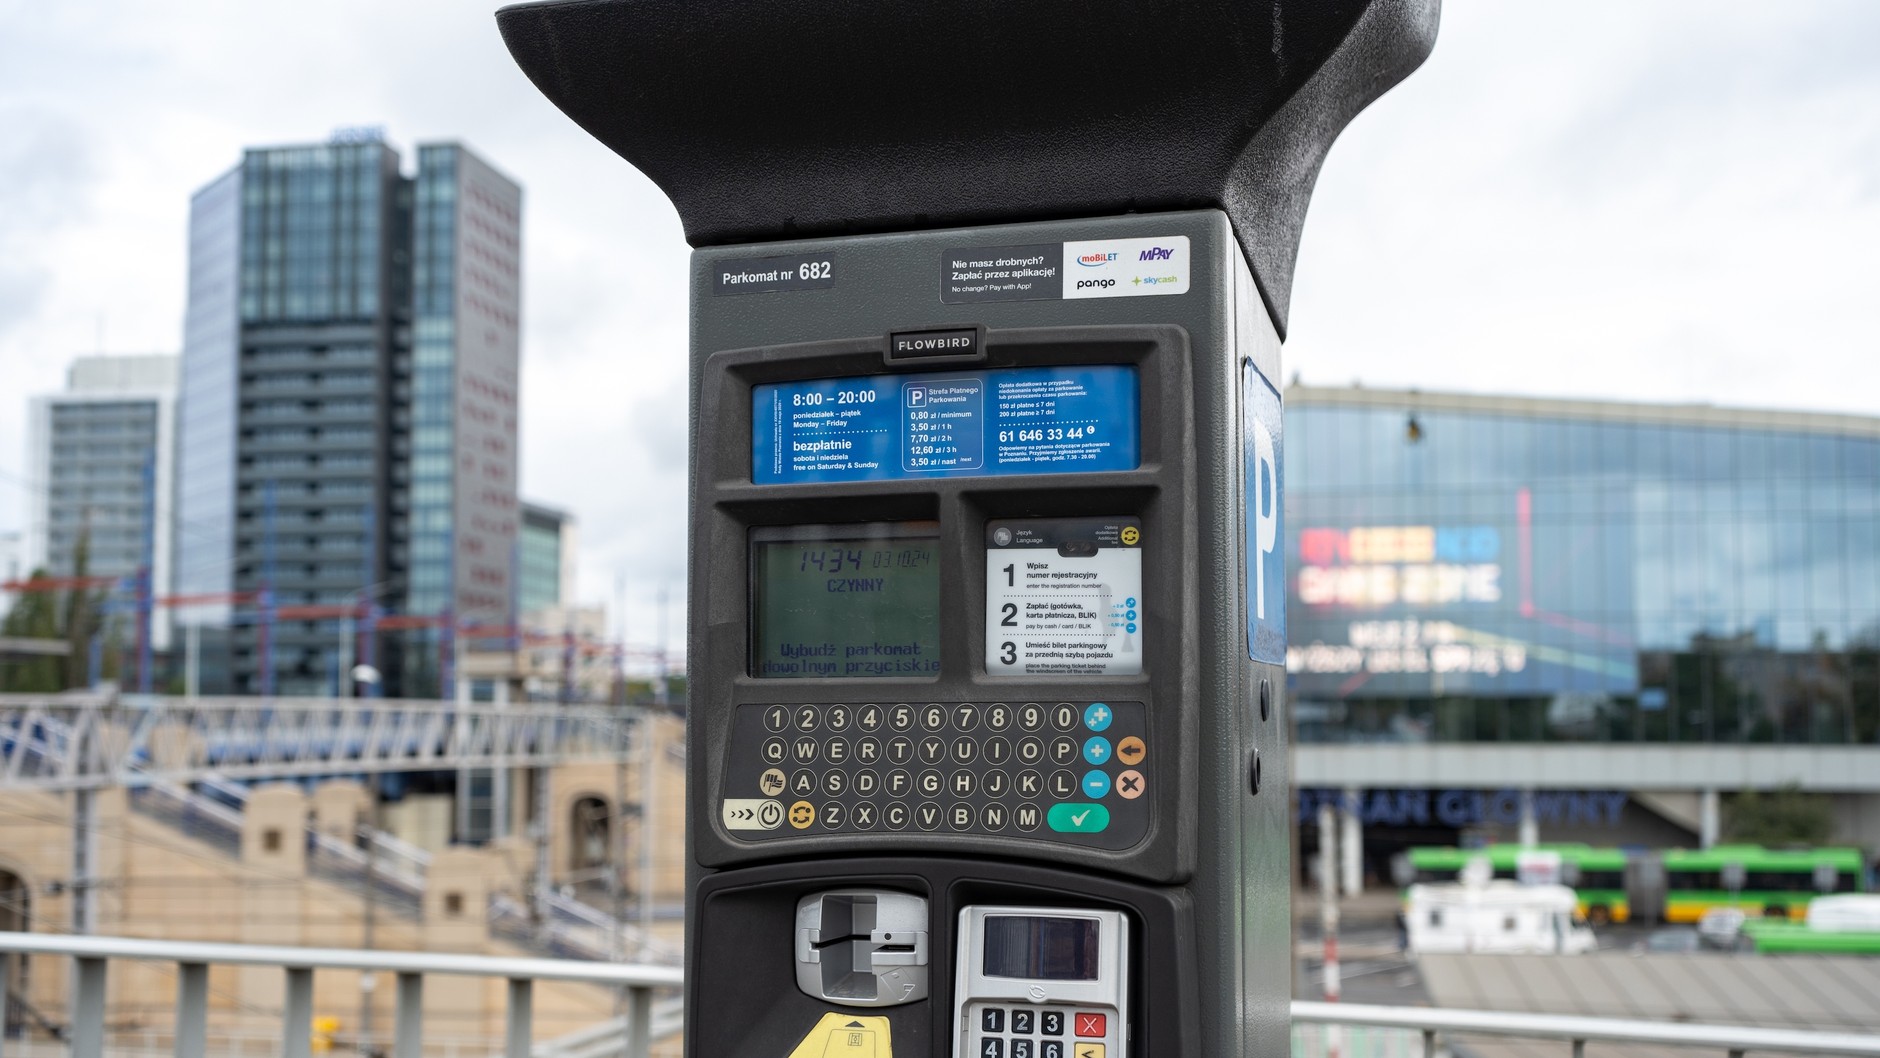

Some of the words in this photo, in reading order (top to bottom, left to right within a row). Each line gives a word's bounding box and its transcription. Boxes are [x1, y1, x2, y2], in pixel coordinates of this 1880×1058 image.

[1139, 247, 1174, 261] MPAY
[952, 260, 967, 268] Nie
[996, 256, 1044, 267] drobnych?
[723, 270, 778, 284] Parkomat
[781, 270, 793, 280] nr
[799, 262, 830, 280] 682
[952, 271, 982, 281] Zapłać
[984, 272, 1010, 280] przez
[1012, 268, 1056, 278] aplikację!
[1077, 278, 1116, 290] pango
[1144, 276, 1177, 285] skycash
[898, 338, 970, 350] FLOWBIRD
[793, 392, 822, 406] 8:00
[838, 390, 876, 404] 20:00
[912, 390, 922, 404] P
[793, 411, 834, 420] poniedziałek
[841, 410, 861, 418] piątek
[910, 412, 928, 420] 0,80
[910, 423, 928, 432] 3,50
[910, 434, 928, 444] 7,70
[999, 430, 1014, 442] 61
[1019, 429, 1043, 442] 646
[1047, 428, 1063, 440] 33
[1067, 428, 1083, 439] 44
[793, 439, 852, 452] bezpłatnie
[910, 446, 933, 455] 12,60
[911, 458, 928, 467] 3,50
[1254, 416, 1277, 620] P
[1004, 564, 1014, 587] 1
[828, 578, 884, 593] CZYNNY
[1000, 603, 1018, 626] 2
[780, 642, 836, 658] Wybudź
[846, 642, 921, 658] parkomat
[1000, 642, 1017, 665] 3
[762, 659, 836, 673] dowolnym
[772, 710, 780, 728] 1
[801, 710, 813, 728] 2
[832, 709, 844, 728] 3
[864, 709, 876, 727] 4
[896, 709, 908, 727] 5
[928, 708, 940, 726] 6
[960, 708, 972, 726] 7
[992, 708, 1004, 726] 8
[1026, 708, 1038, 726] 9
[1058, 708, 1070, 726] 0
[768, 742, 782, 759] Q
[798, 743, 815, 758] W
[832, 743, 842, 758] E
[862, 743, 875, 758] R
[894, 743, 906, 758] T
[926, 743, 938, 758] Y
[958, 743, 970, 758] U
[995, 743, 998, 758] I
[1023, 742, 1038, 758] O
[1058, 743, 1070, 758] P
[796, 775, 810, 790] A
[829, 775, 840, 790] S
[860, 775, 873, 790] D
[893, 775, 904, 790] F
[924, 776, 938, 791] G
[956, 776, 969, 791] H
[990, 776, 1000, 792] J
[1023, 776, 1036, 792] K
[1058, 776, 1068, 792] L
[826, 808, 839, 824] Z
[858, 808, 870, 824] X
[890, 808, 903, 824] C
[922, 808, 936, 824] V
[956, 808, 968, 824] B
[988, 809, 1000, 825] N
[1020, 809, 1035, 825] M
[988, 1012, 996, 1028] 1
[1017, 1014, 1028, 1030] 2
[1047, 1014, 1058, 1032] 3
[986, 1042, 997, 1058] 4
[1016, 1043, 1027, 1058] 5
[1046, 1044, 1058, 1058] 6
